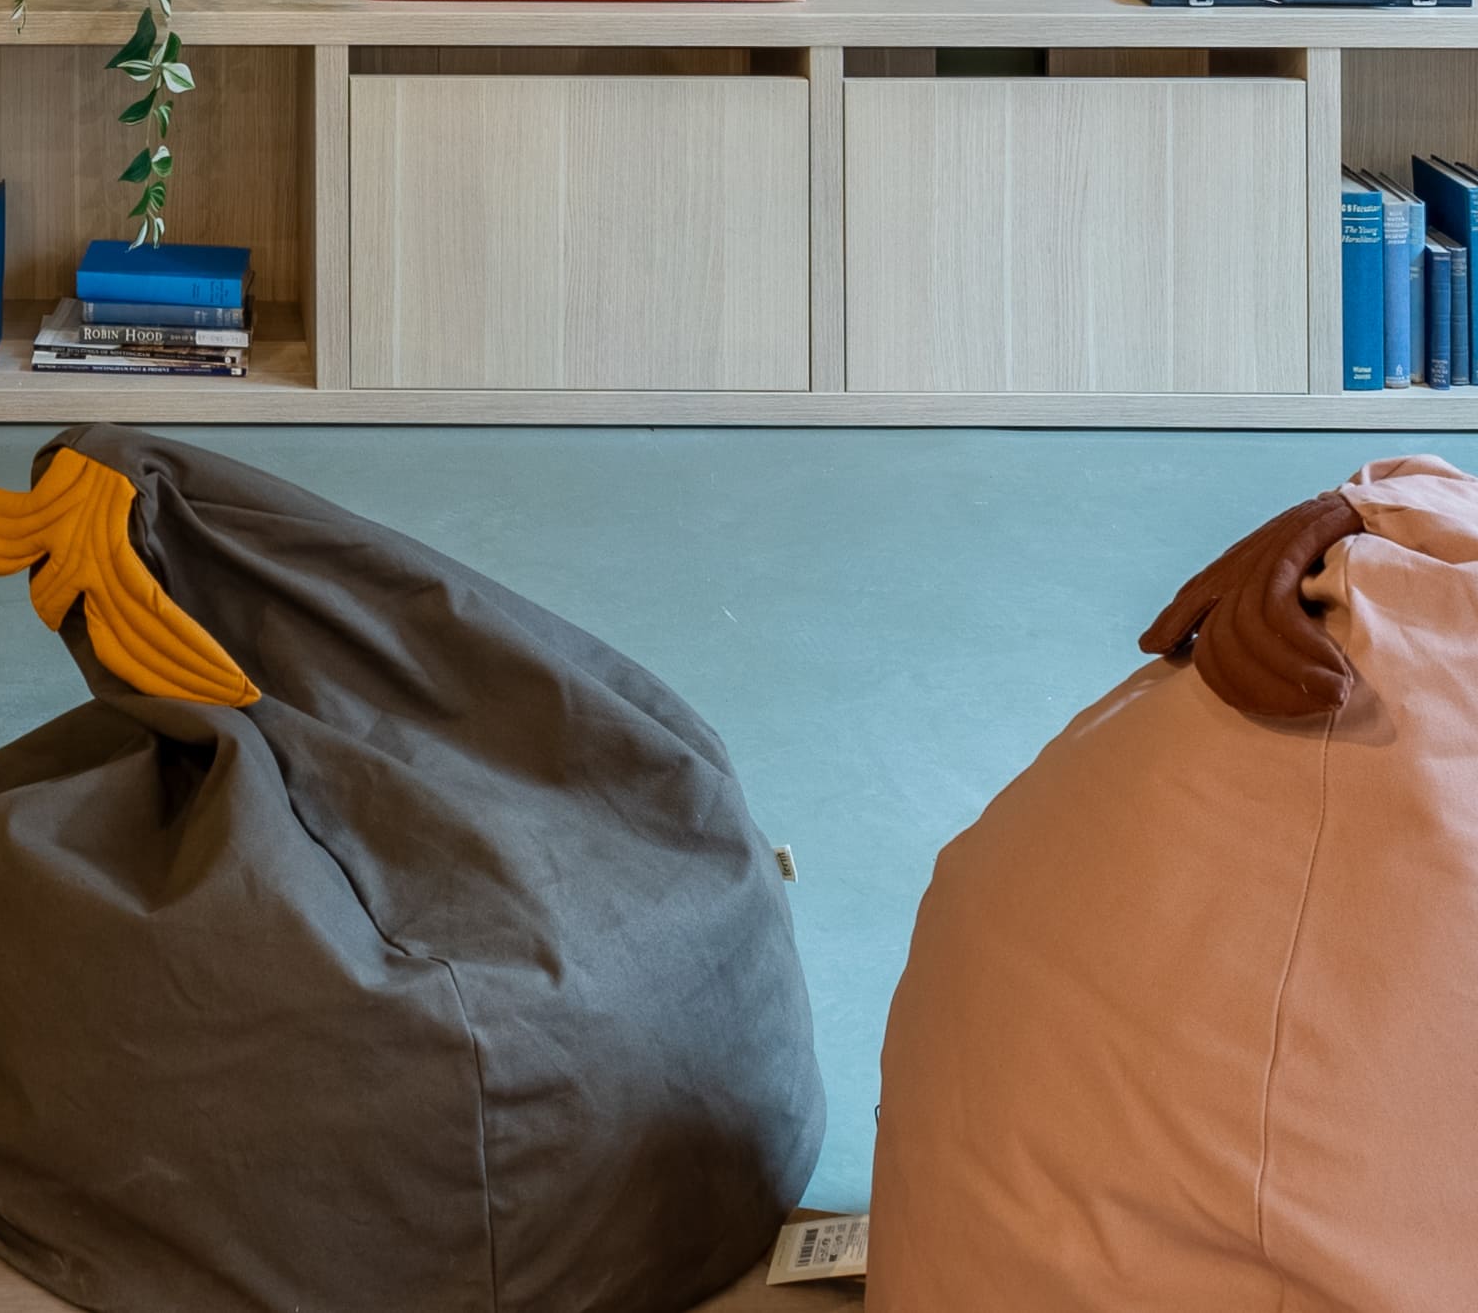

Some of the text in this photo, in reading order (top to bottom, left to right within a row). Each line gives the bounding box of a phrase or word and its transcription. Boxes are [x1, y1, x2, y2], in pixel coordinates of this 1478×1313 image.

[1345, 226, 1357, 234] The
[84, 327, 119, 341] ROBIN
[125, 328, 163, 342] HOOD
